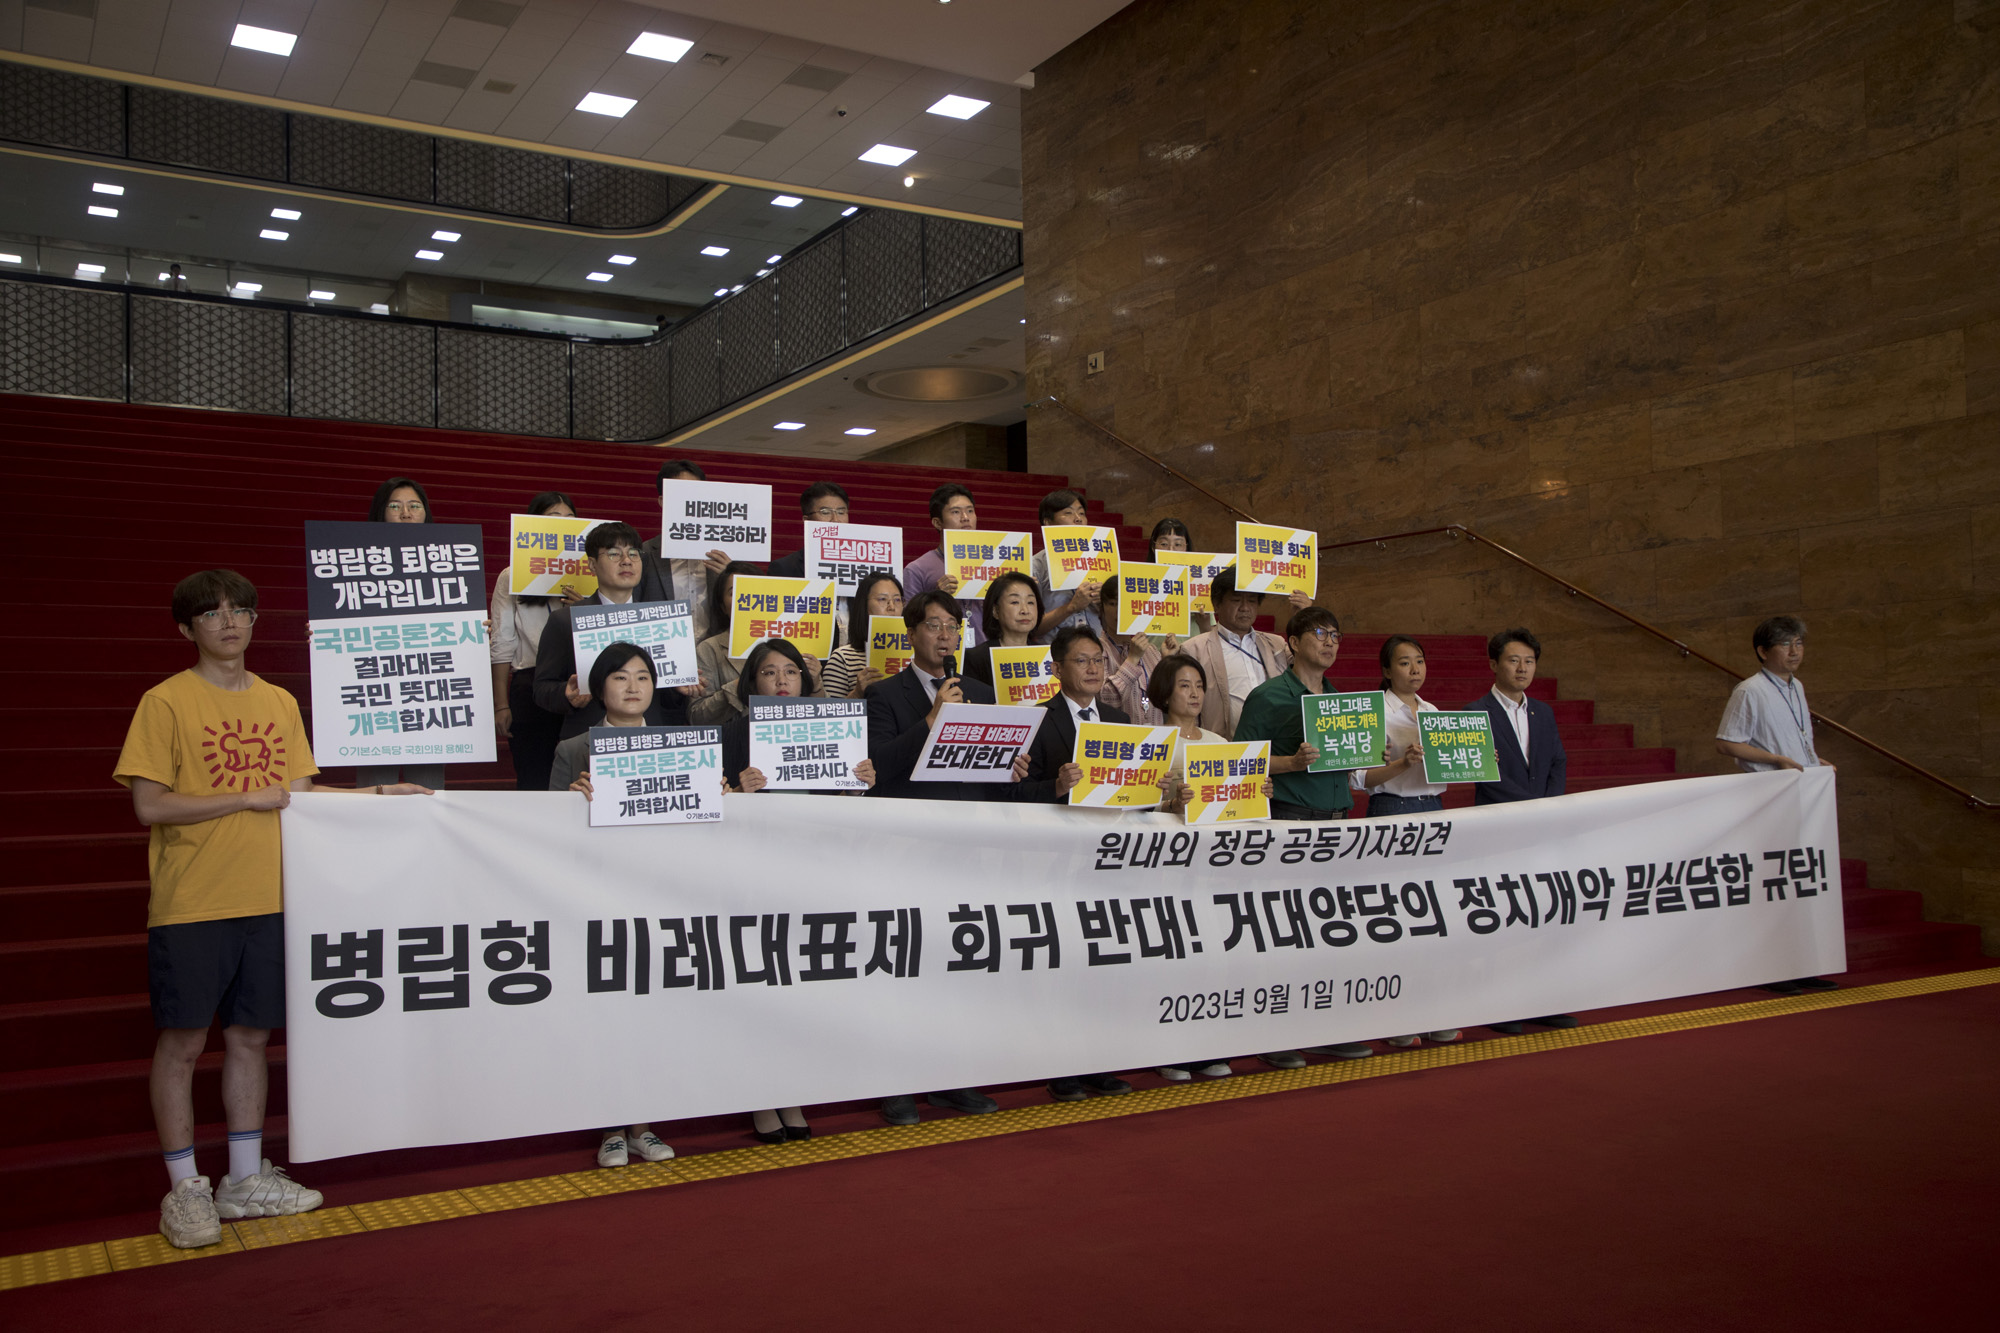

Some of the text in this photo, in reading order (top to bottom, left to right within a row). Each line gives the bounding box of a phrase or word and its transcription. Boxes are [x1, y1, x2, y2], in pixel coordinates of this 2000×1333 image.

[685, 501, 748, 520] 비례의석
[516, 532, 558, 550] 선거법
[669, 522, 766, 544] 상향 조정하라
[812, 526, 838, 538] 선거법
[822, 539, 891, 562] 밀실야합
[953, 544, 1024, 562] 병립형 회귀
[1052, 538, 1113, 554] 병립형 회귀
[1244, 537, 1311, 560] 병립형 회귀
[310, 543, 480, 578] 병립형 퇴행은
[1062, 558, 1112, 572] 반대한다!
[1250, 558, 1306, 579] 반대한다!
[332, 576, 468, 610] 개악입니다
[1125, 577, 1160, 594] 병립형
[1162, 579, 1184, 596] 회귀
[737, 594, 832, 614] 선거법 밀실담합
[1131, 600, 1180, 617] 반대한다!
[576, 602, 688, 630] 병립형 퇴행은 개악입니다
[314, 620, 486, 654] 국민공론조사
[749, 620, 819, 639] 중단하라!
[354, 652, 454, 679] 결과대로
[1000, 660, 1040, 680] 병립형
[340, 678, 474, 708] 국민 뜻대로
[754, 702, 864, 720] 병립형 퇴행은 개악입니다
[1318, 698, 1372, 714] 민심 그대로
[348, 704, 475, 736] 개혁합시다
[1316, 712, 1378, 732] 선거제도 개혁
[1422, 716, 1488, 730] 선거제도 바뀌면
[594, 729, 718, 754] 병립형 퇴행은 개악입니다
[755, 720, 862, 744] 국민공론조사
[941, 724, 1029, 742] 병립형 비례제
[1428, 732, 1486, 746] 정치가 바뀐다
[350, 745, 402, 756] 기본소득당
[404, 744, 443, 755] 국회의원
[782, 744, 840, 762] 결과대로
[1084, 740, 1169, 762] 병립형 회귀
[1324, 732, 1372, 756] 녹색당
[596, 748, 717, 778] 국민공론조사
[926, 745, 1020, 770] 반대한다
[1188, 757, 1266, 778] 선거법 밀실담합
[1438, 748, 1482, 769] 녹색당
[776, 762, 848, 782] 개혁합시다
[1090, 766, 1157, 787] 반대한다!
[626, 774, 692, 796] 결과대로
[1201, 782, 1256, 802] 중단하라!
[619, 793, 701, 818] 개혁합시다
[1094, 822, 1452, 870] 원내외 정당 공동기자회견
[310, 846, 1828, 1018] 병립형 비례대표제 회귀 반대! 거대양당의 정치개악 밀실담합 규탄!
[1159, 974, 1402, 1024] 2023년 9월 1일 10:00
